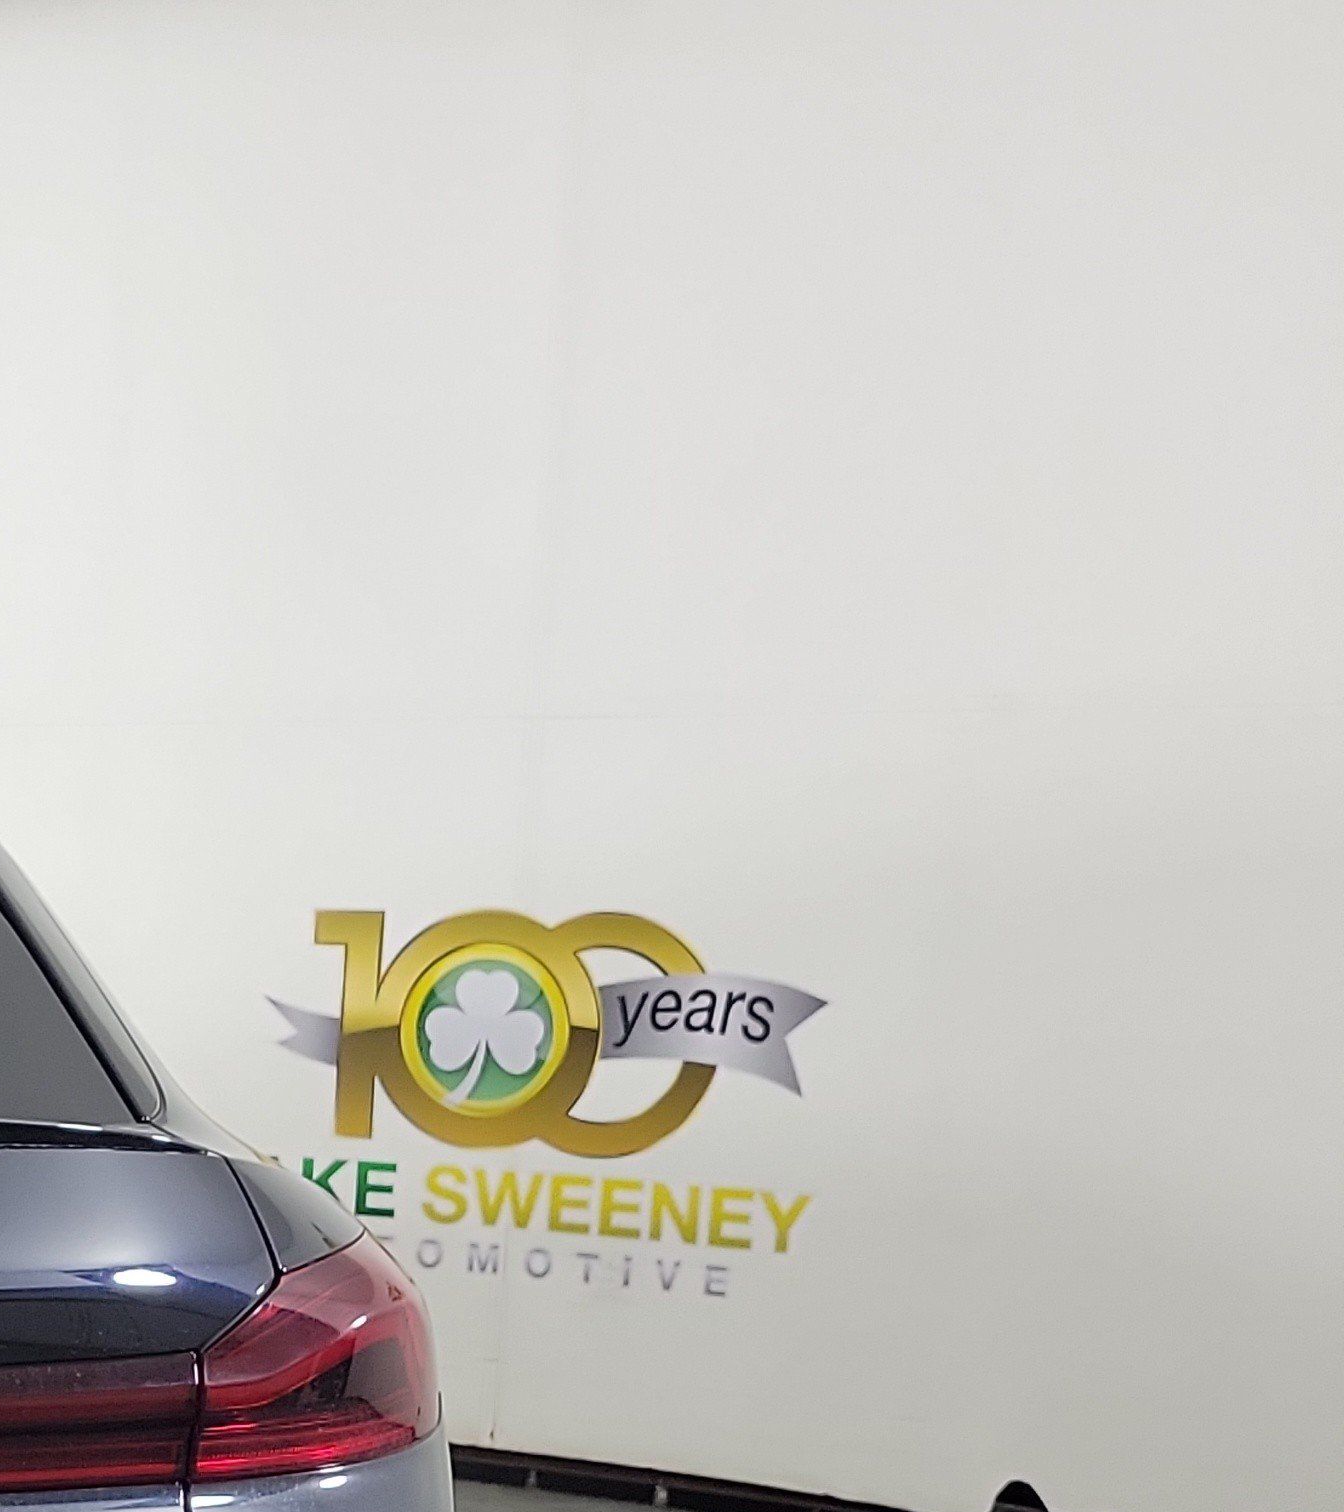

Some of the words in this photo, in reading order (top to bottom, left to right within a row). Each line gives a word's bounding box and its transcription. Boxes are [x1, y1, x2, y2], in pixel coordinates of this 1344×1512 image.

[613, 987, 775, 1047] years
[300, 1156, 397, 1218] KE
[422, 1163, 814, 1254] SWEENEY
[376, 1236, 731, 1297] OMOTIVE
